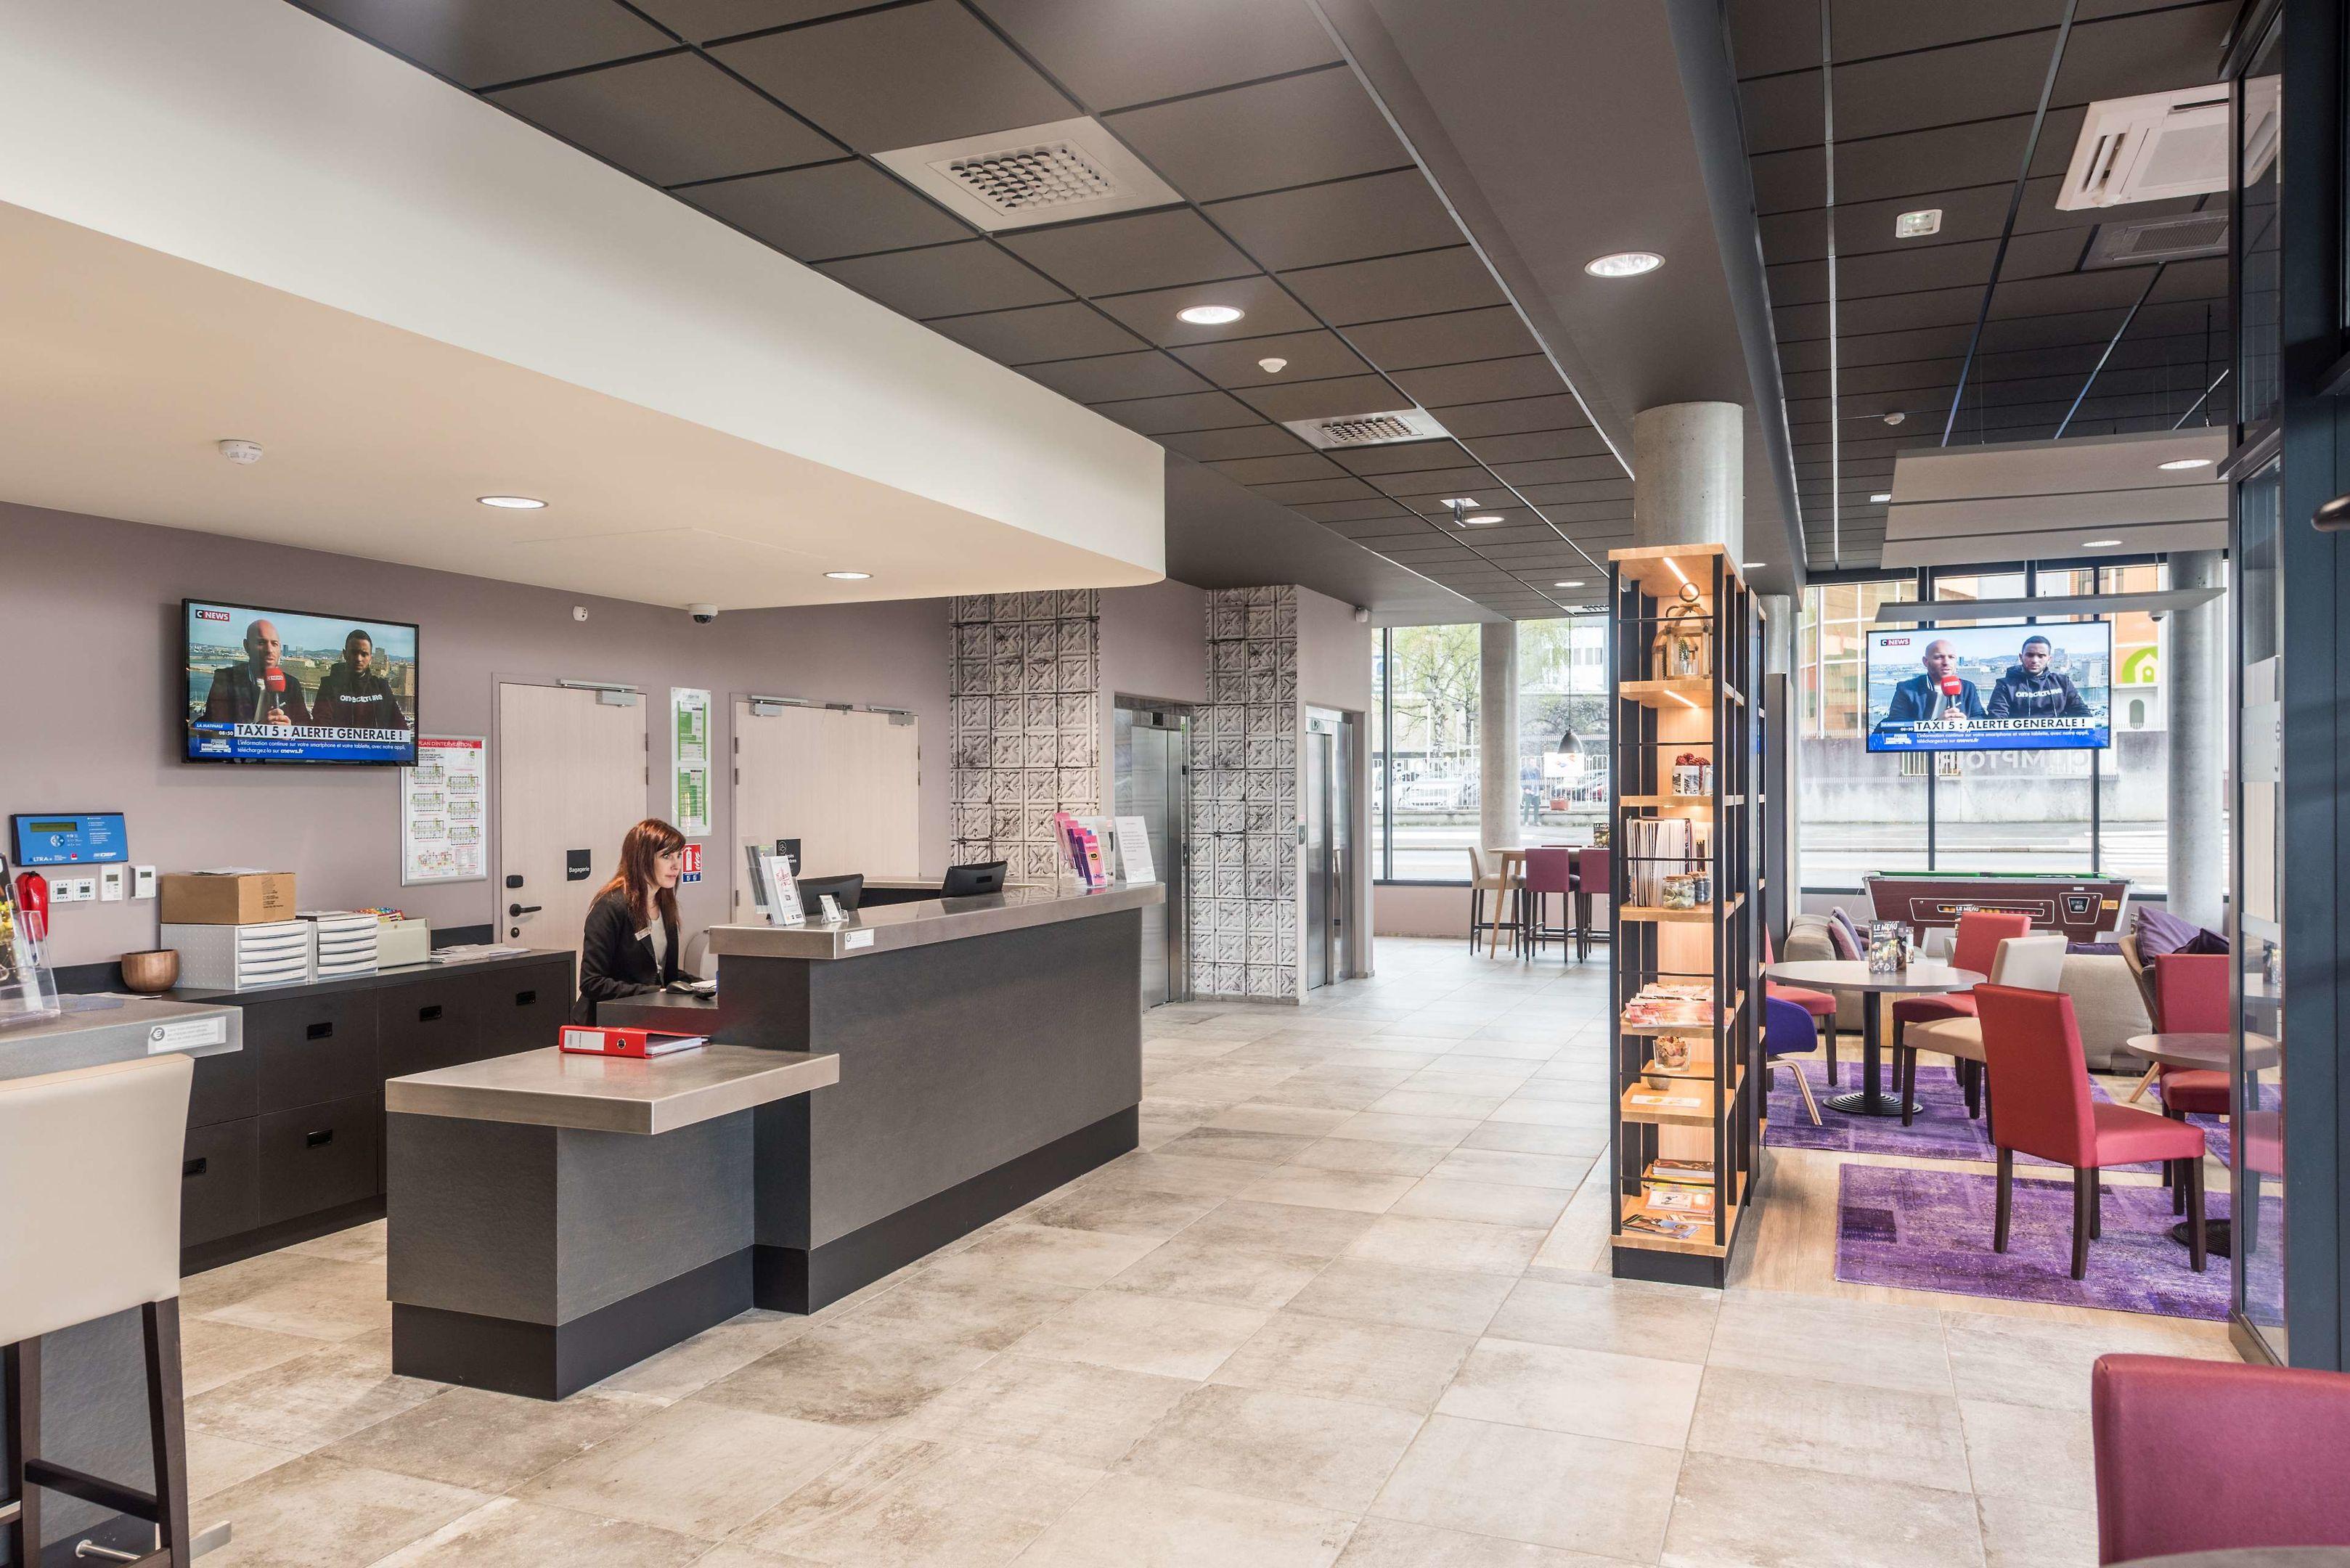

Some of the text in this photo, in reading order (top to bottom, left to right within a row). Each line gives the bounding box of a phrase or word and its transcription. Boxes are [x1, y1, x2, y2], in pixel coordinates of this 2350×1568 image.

[205, 611, 229, 621] NEWS
[1917, 722, 1944, 730] TAXI
[1949, 721, 1955, 730] 5
[1967, 720, 2009, 730] ALERTE
[2013, 718, 2078, 728] GENERALE
[237, 724, 268, 737] TAXI
[272, 726, 280, 737] 5
[291, 727, 333, 738] ALERTE
[337, 728, 396, 740] GENERALE
[399, 730, 402, 740] !
[1882, 923, 1898, 931] MENU
